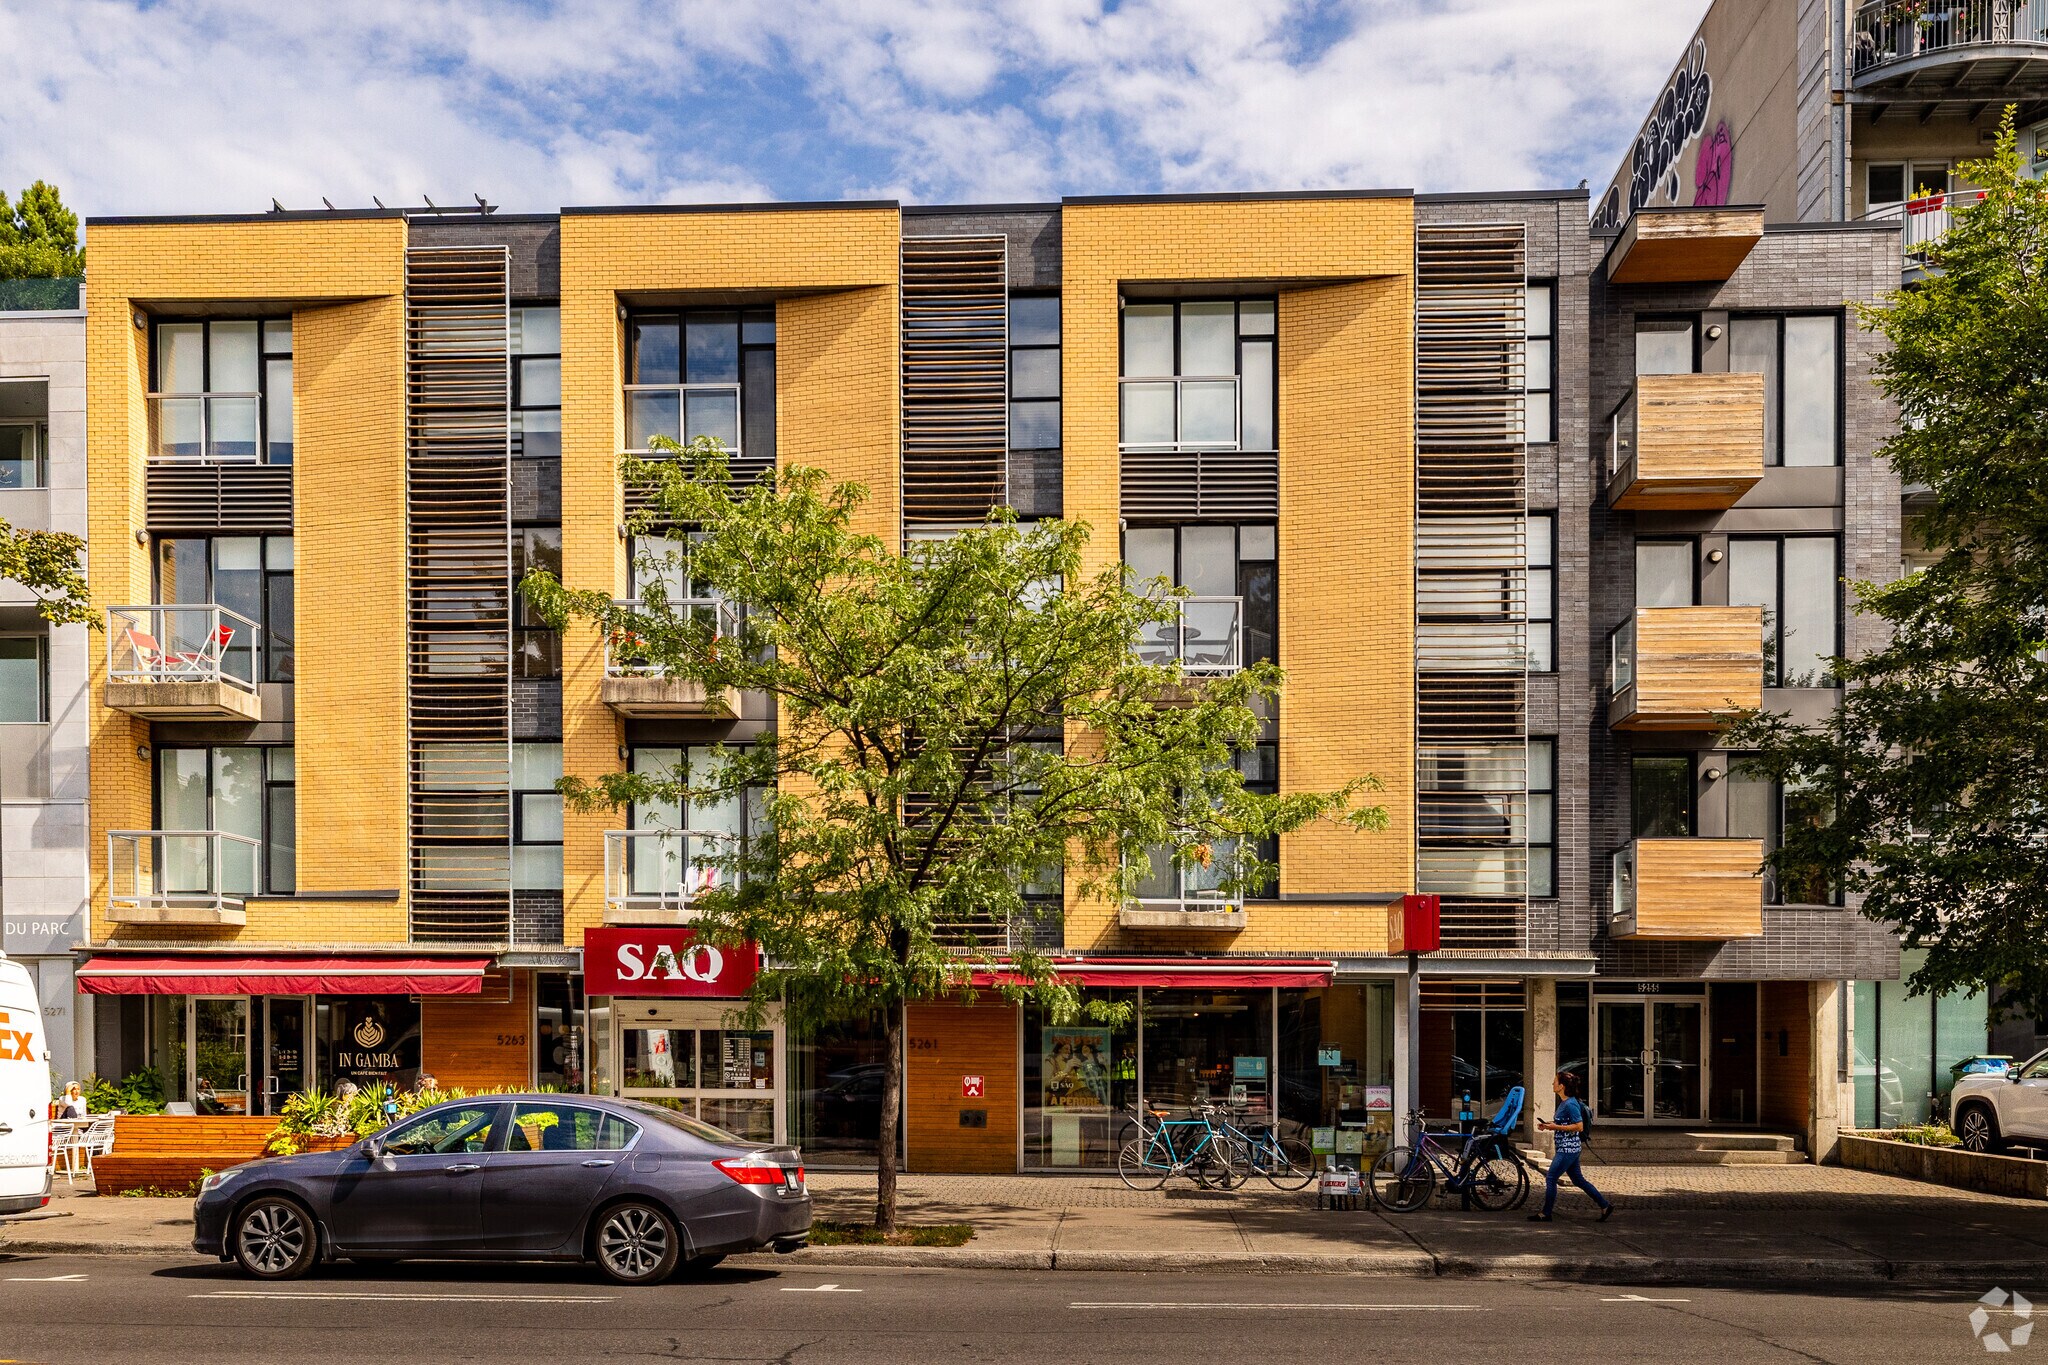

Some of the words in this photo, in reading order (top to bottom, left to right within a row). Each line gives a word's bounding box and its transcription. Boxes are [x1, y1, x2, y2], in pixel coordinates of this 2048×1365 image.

[6, 922, 27, 935] DU
[32, 922, 70, 935] PARC
[617, 943, 724, 983] SAQ
[43, 1007, 66, 1017] 5271
[497, 1035, 526, 1046] 5263
[909, 1038, 938, 1050] 5261
[338, 1052, 352, 1067] IN
[355, 1052, 399, 1068] GAMBA
[1060, 1081, 1074, 1089] SAQ
